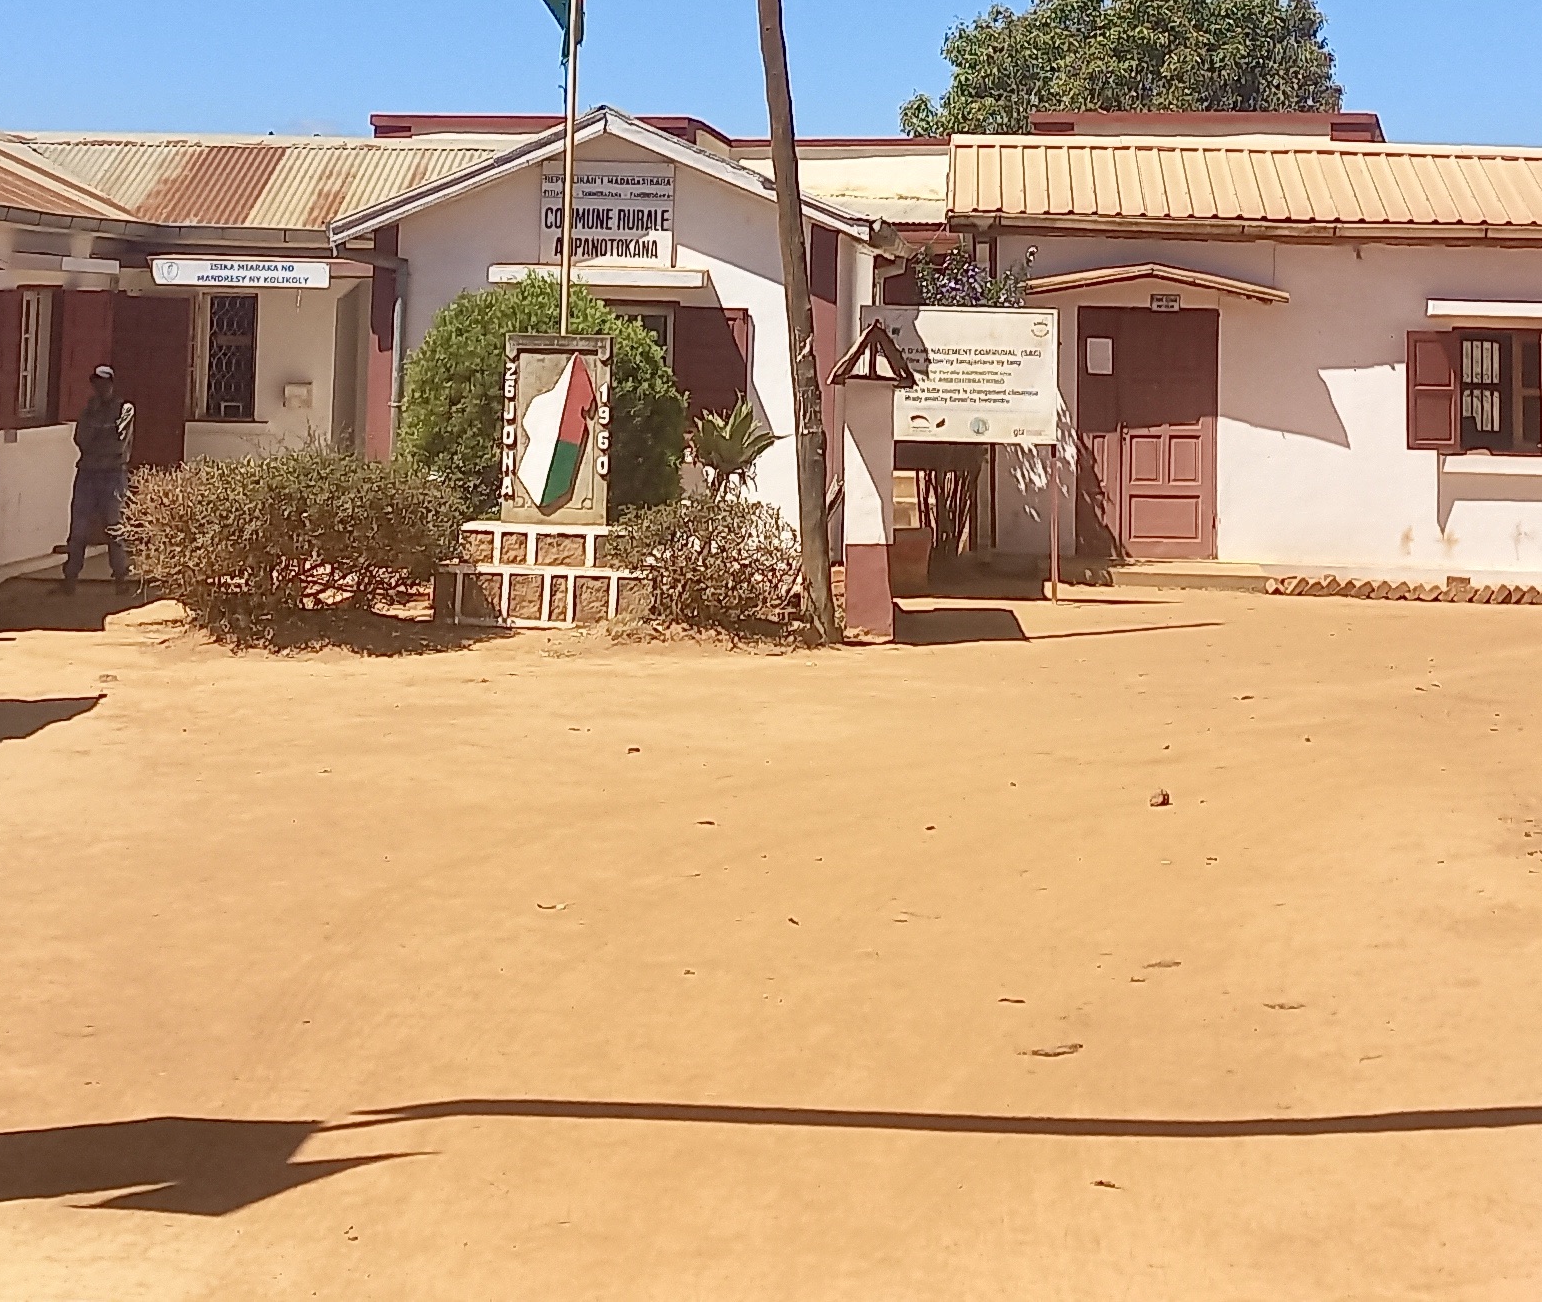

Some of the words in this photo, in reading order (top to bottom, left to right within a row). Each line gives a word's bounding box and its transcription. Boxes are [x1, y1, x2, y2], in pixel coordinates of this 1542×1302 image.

[544, 206, 614, 231] COMUNE
[616, 208, 672, 232] RURALE
[553, 236, 659, 259] APANOTOKANA
[280, 264, 295, 273] NO
